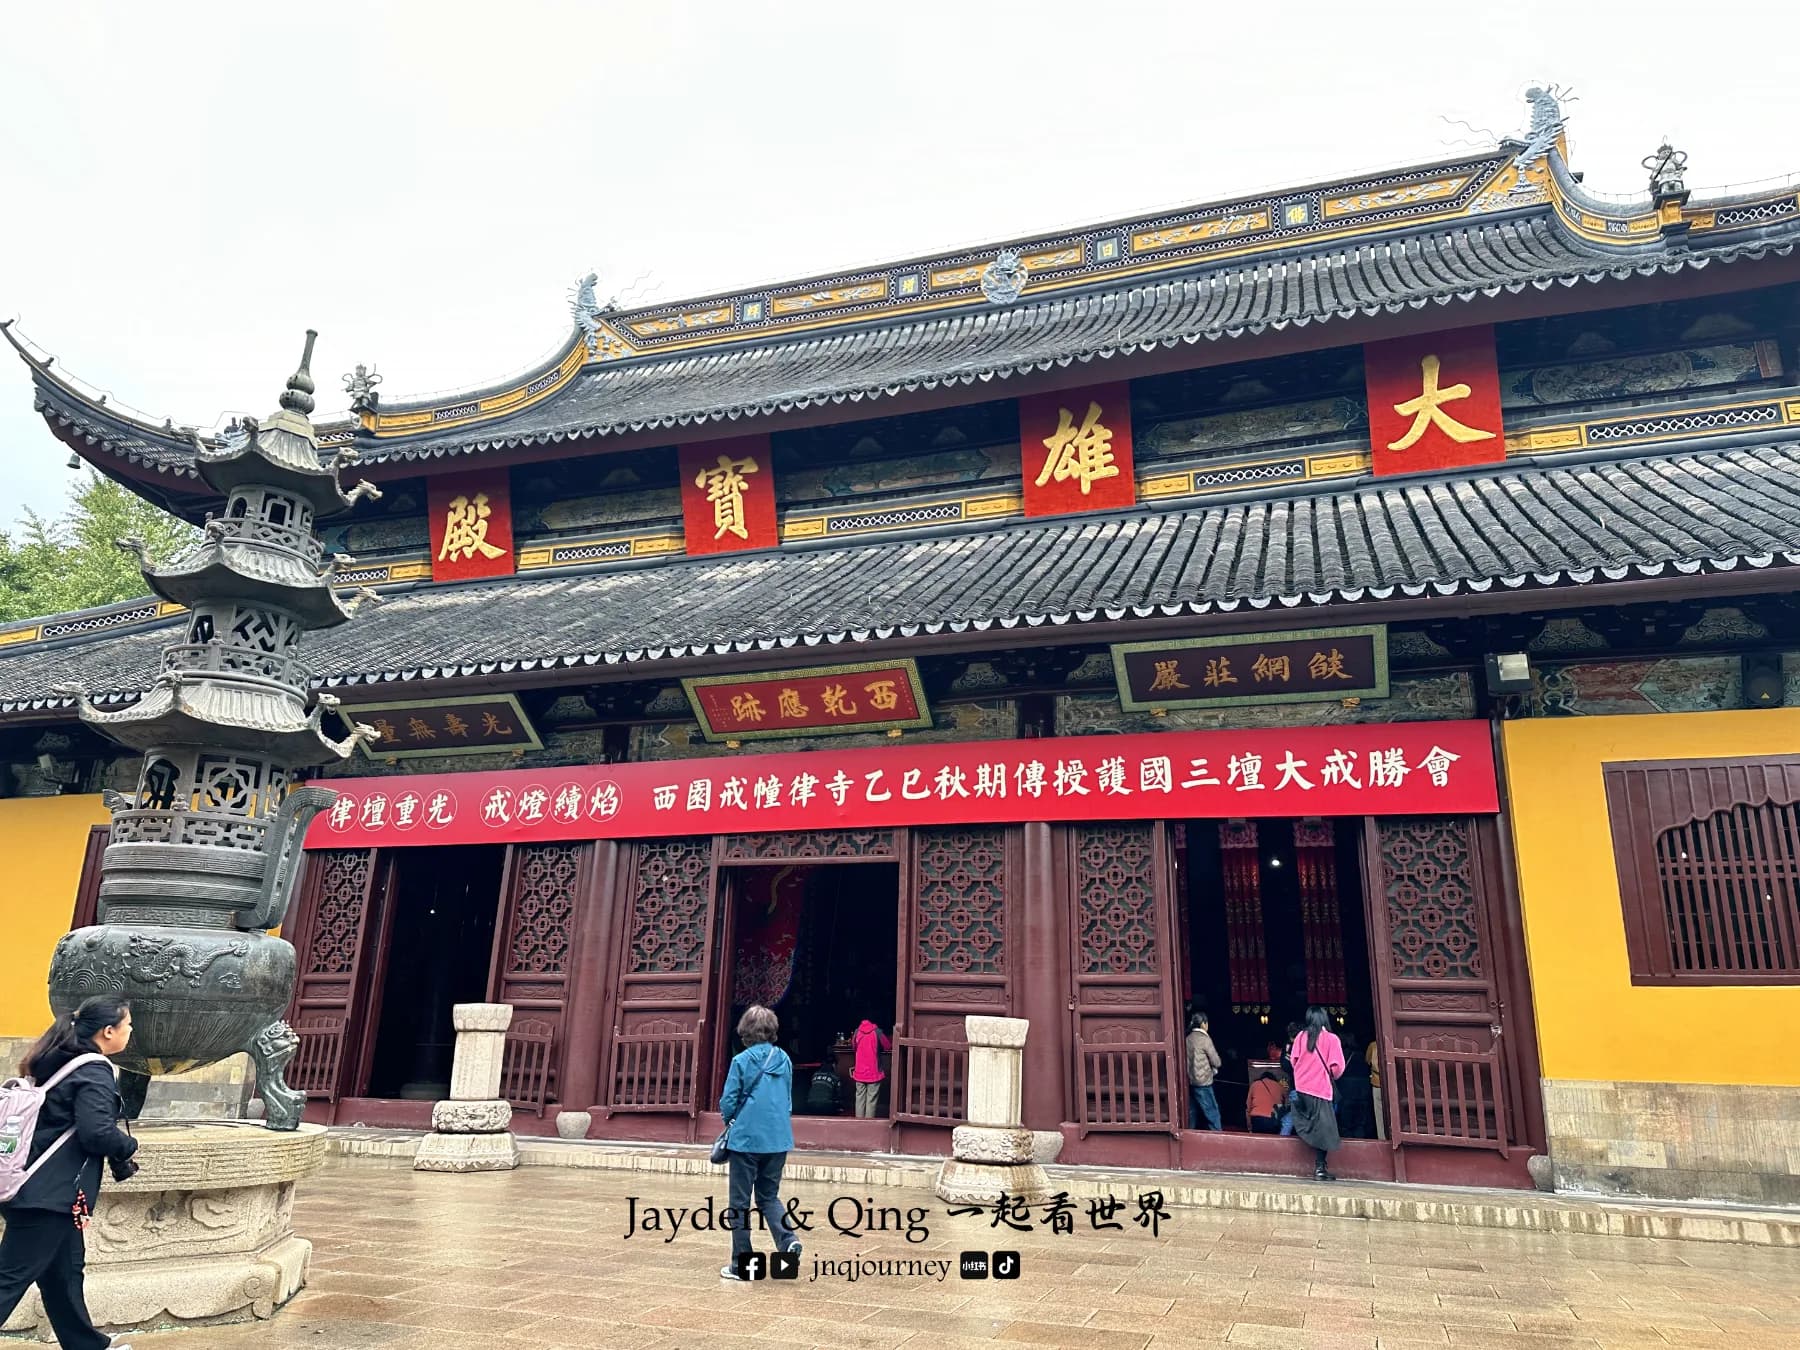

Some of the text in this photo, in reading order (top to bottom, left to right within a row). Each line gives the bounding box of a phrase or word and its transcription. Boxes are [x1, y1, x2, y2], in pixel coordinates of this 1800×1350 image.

[1387, 354, 1497, 451] 大
[1035, 401, 1120, 495] 雄
[438, 492, 508, 562] 殿
[695, 454, 759, 540] 寶
